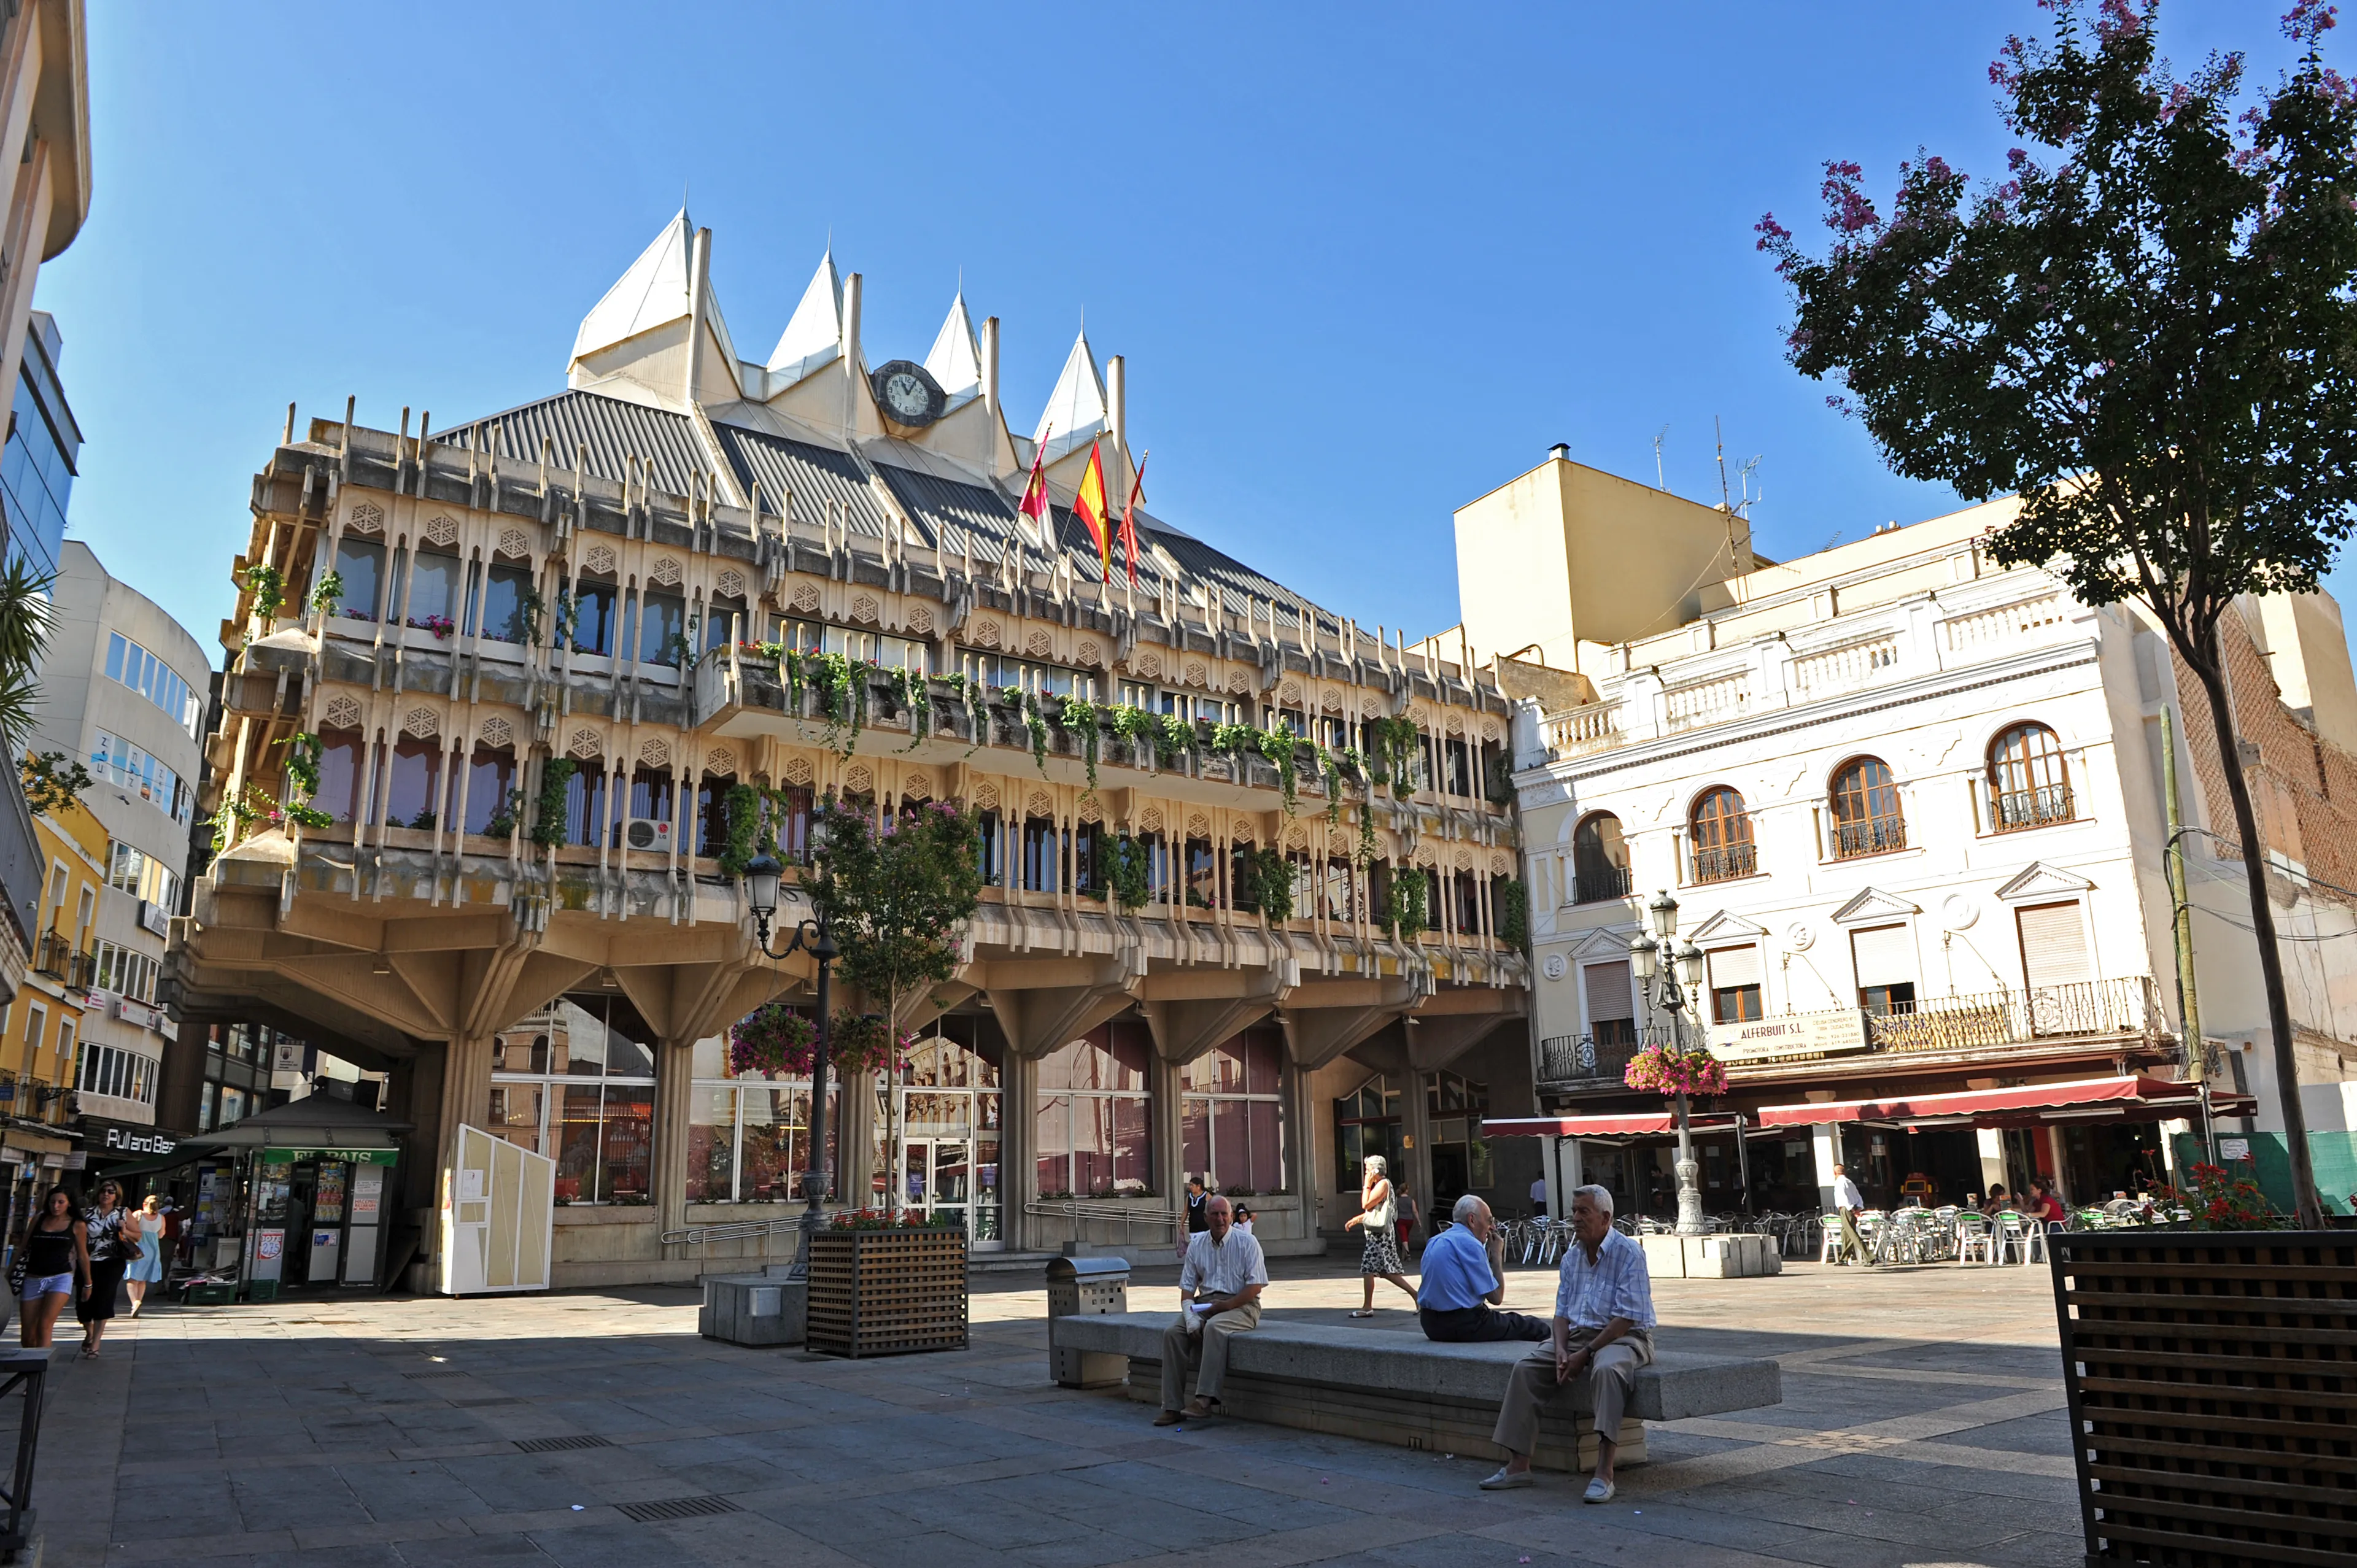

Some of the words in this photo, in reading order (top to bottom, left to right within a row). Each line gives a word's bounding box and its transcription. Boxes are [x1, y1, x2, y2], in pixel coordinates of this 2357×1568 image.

[1741, 1024, 1786, 1040] ALFERBUIT
[1789, 1022, 1805, 1034] S.L.
[106, 1129, 131, 1149] Pull
[130, 1137, 152, 1152] and
[153, 1135, 176, 1154] Bea
